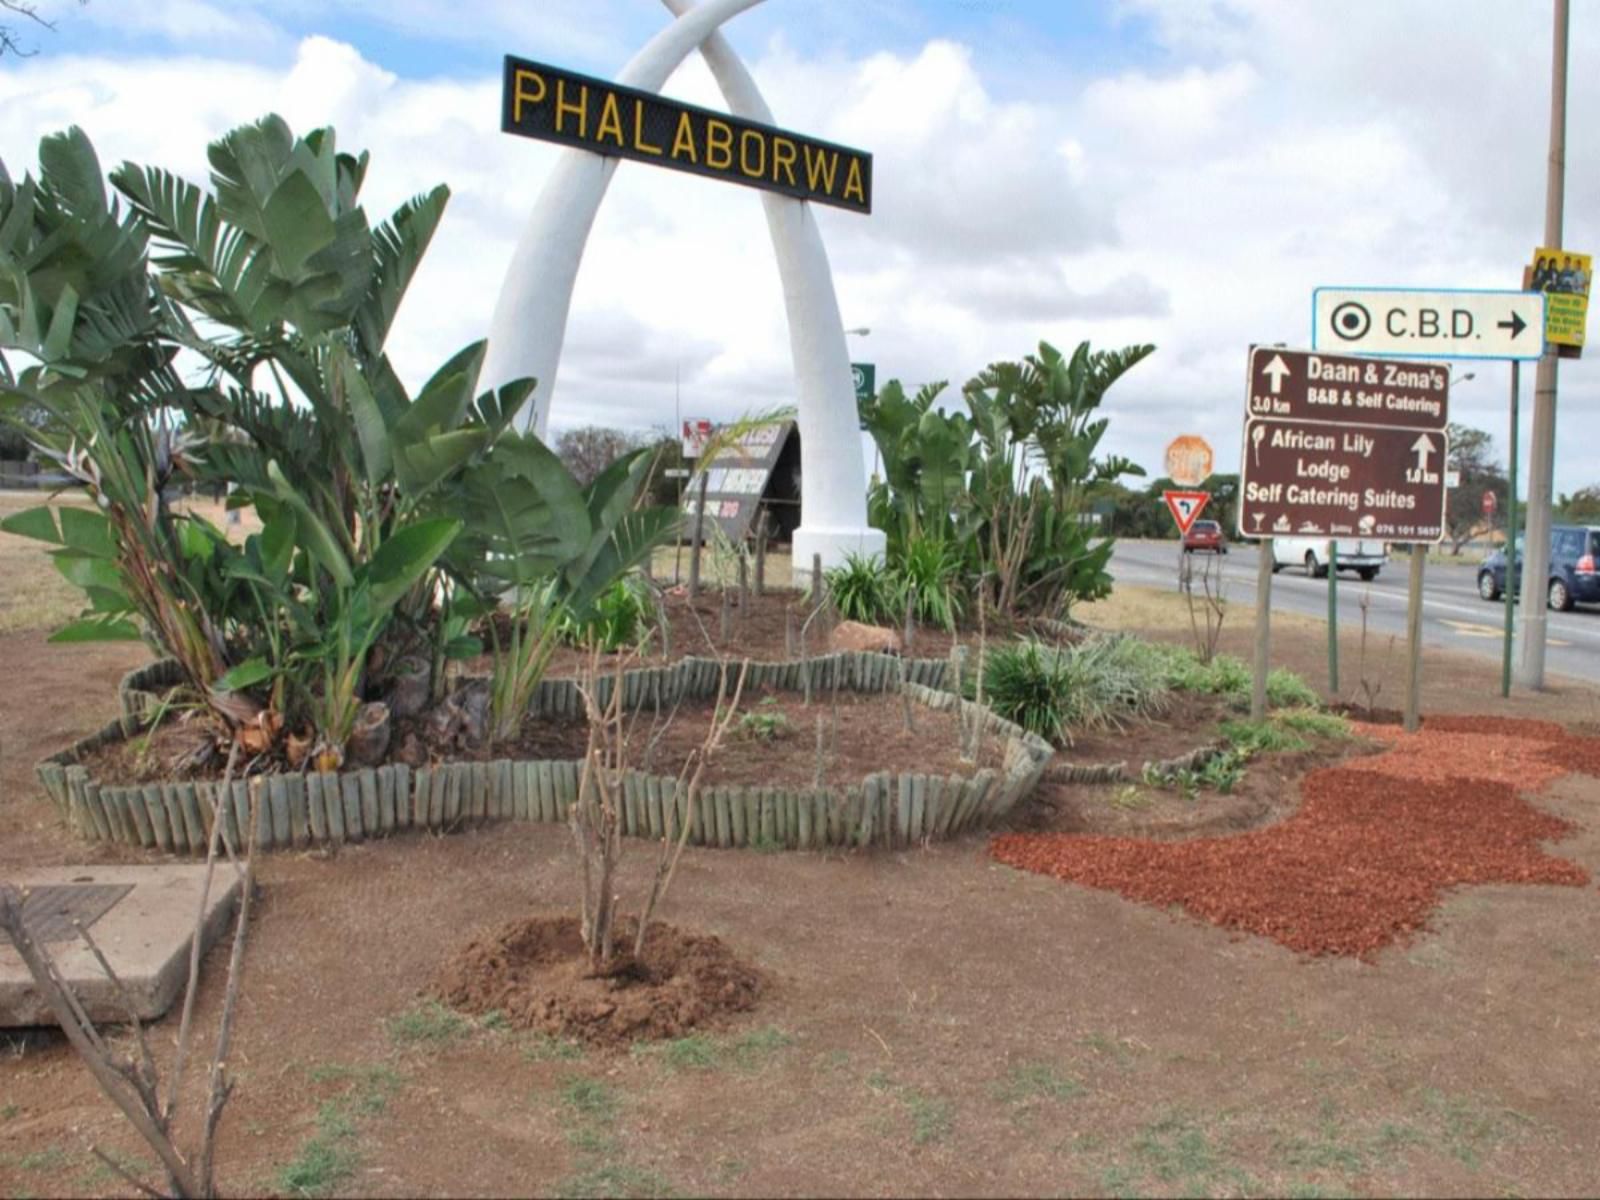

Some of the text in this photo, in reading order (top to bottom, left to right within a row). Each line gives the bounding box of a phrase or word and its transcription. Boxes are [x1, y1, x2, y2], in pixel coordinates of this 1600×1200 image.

[514, 69, 865, 202] PHALABORWA
[1386, 307, 1481, 340] C.B.D.
[1307, 356, 1444, 391] Daan & Zena's
[1252, 396, 1291, 414] 3.0 km
[1307, 387, 1441, 416] B&B & Self Catering
[1271, 429, 1374, 457] African Lily
[1297, 459, 1350, 482] Lodge
[1405, 468, 1440, 485] 1.0 km
[1246, 482, 1416, 511] Self Catering Suites
